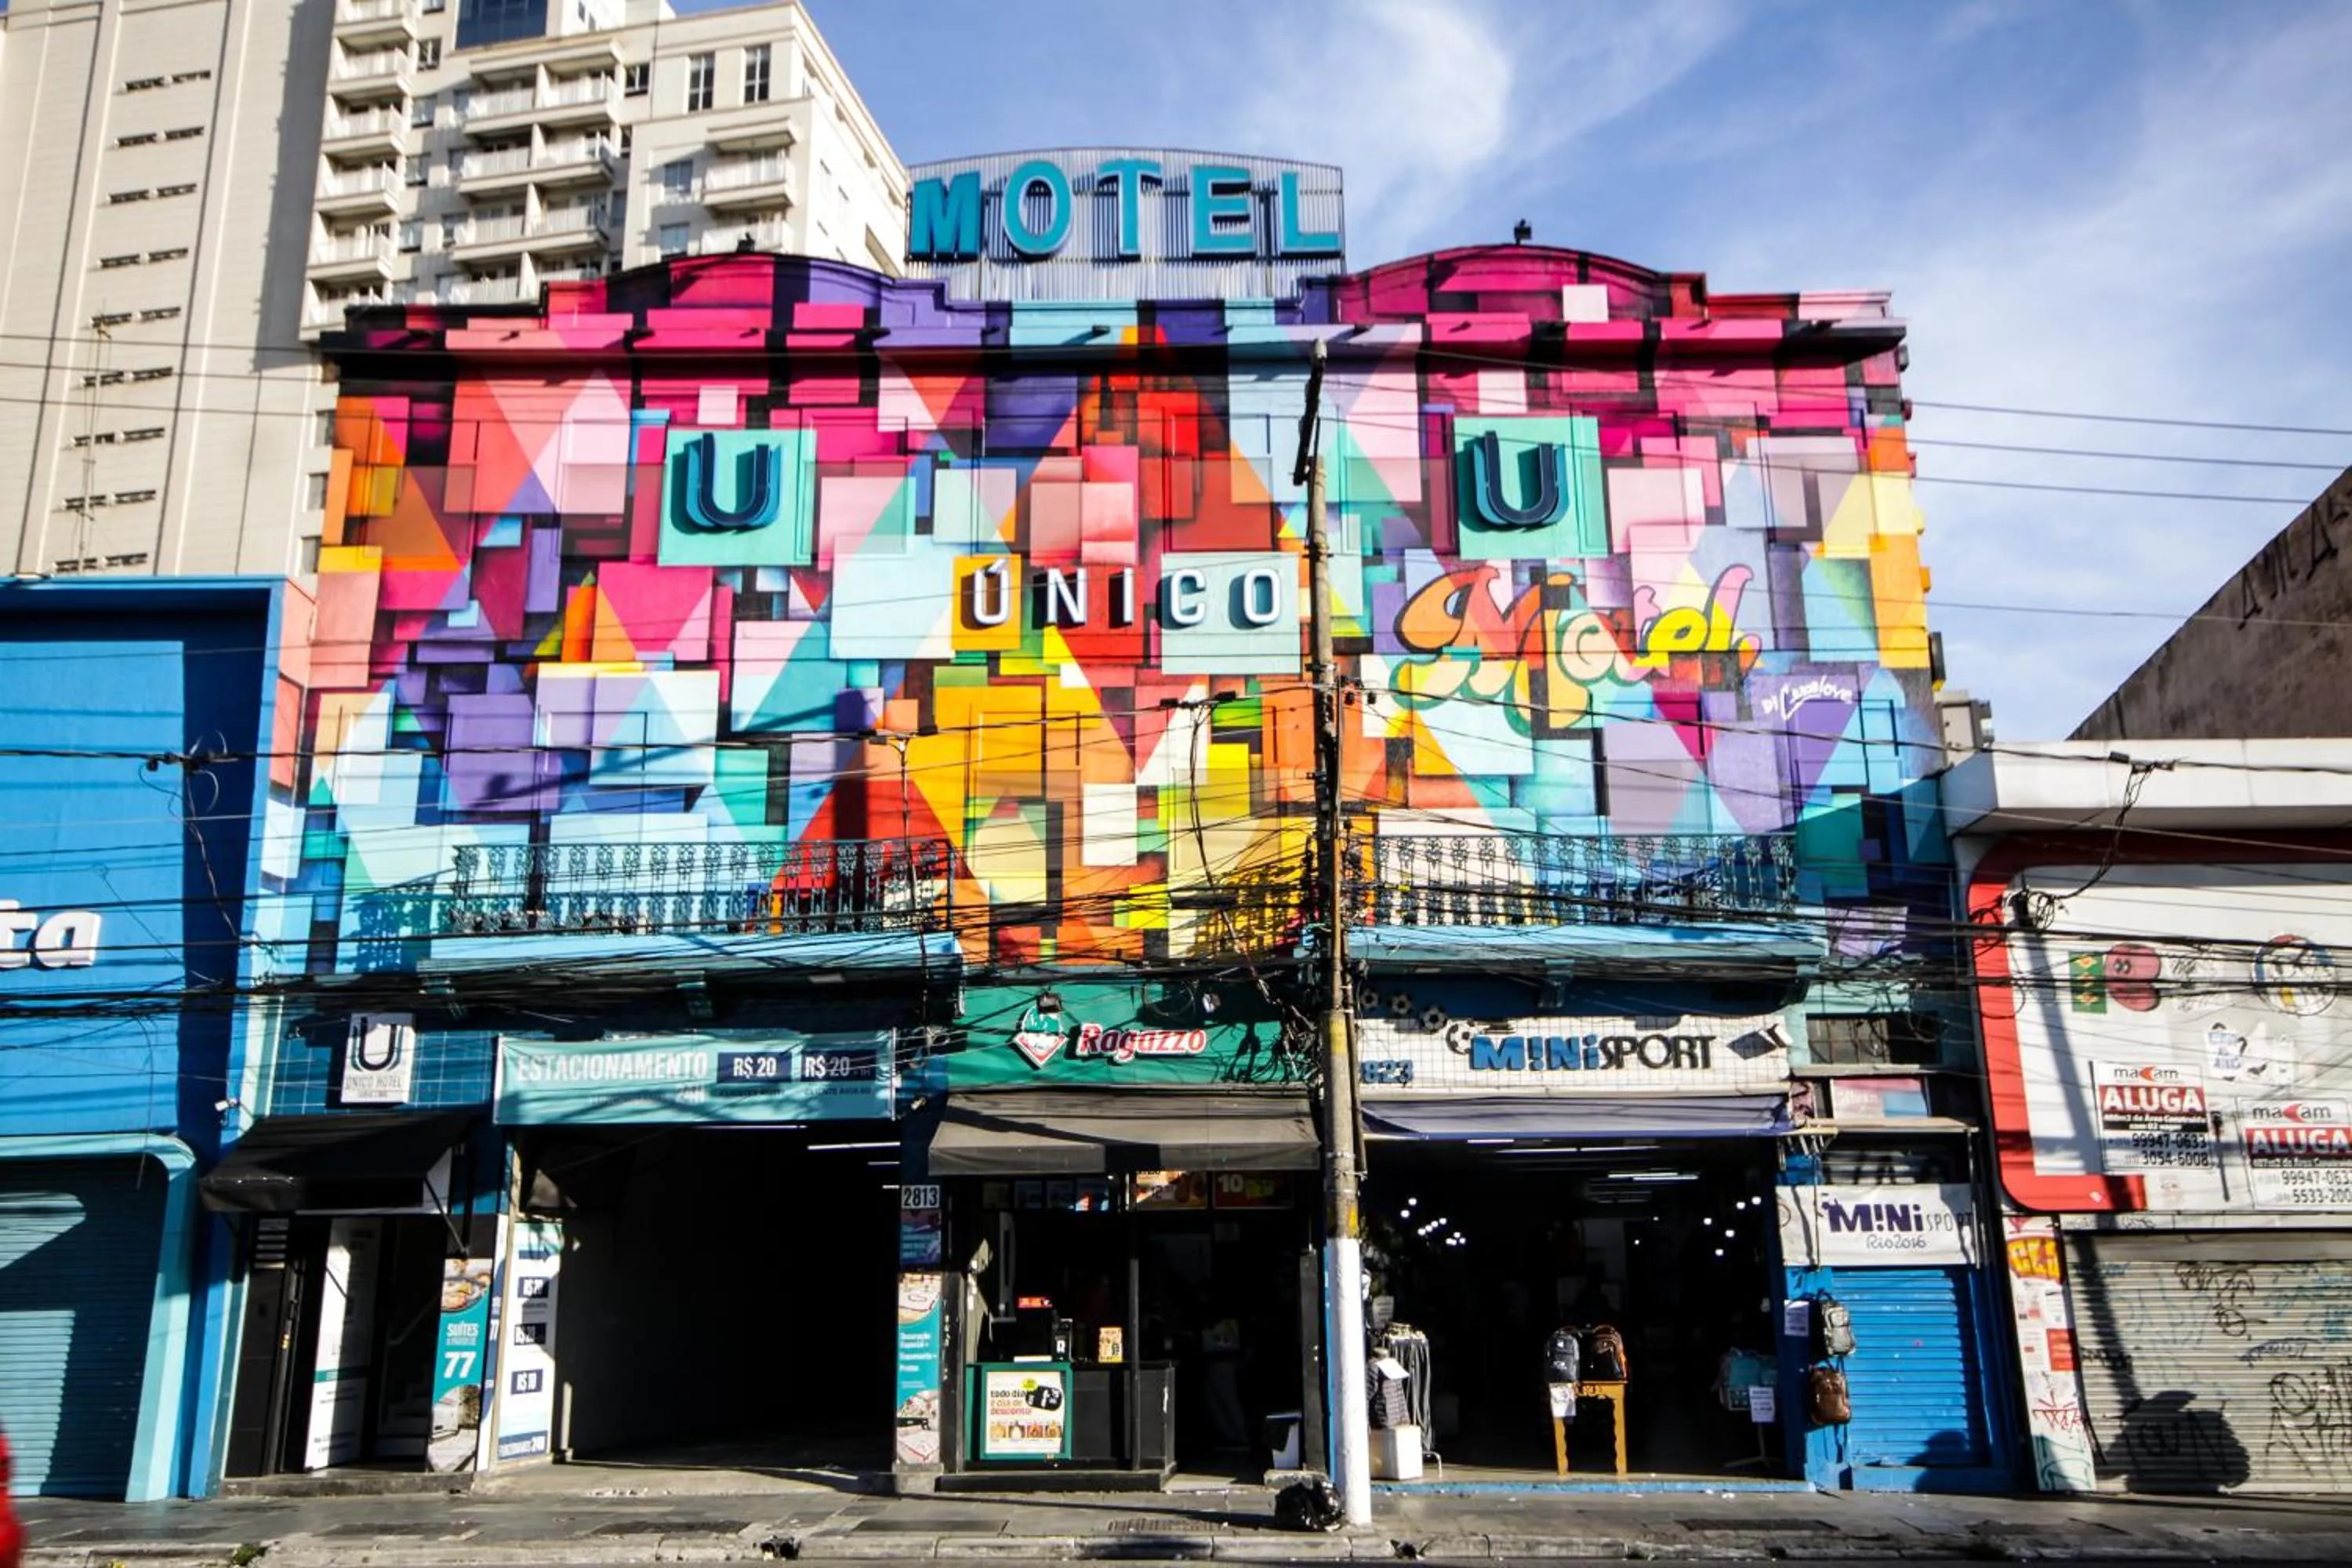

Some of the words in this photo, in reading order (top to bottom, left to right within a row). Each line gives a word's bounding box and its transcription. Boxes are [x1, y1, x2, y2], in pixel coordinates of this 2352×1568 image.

[908, 158, 1342, 260] MOTEL
[687, 432, 781, 528] U
[1473, 430, 1570, 524] U
[972, 557, 1282, 625] ÚNICO
[1076, 1022, 1207, 1064] Ragazzo
[516, 1051, 709, 1082] ESTACIONAMENTO
[733, 1056, 753, 1080] R$
[757, 1057, 778, 1077] 20
[804, 1055, 826, 1080] R$
[829, 1056, 851, 1077] 20
[2103, 1087, 2204, 1112] ALUGA
[2252, 1129, 2352, 1155] ALUGA
[2281, 1170, 2352, 1185] 99947-063
[902, 1187, 938, 1207] 2813
[444, 1351, 477, 1379] 77
